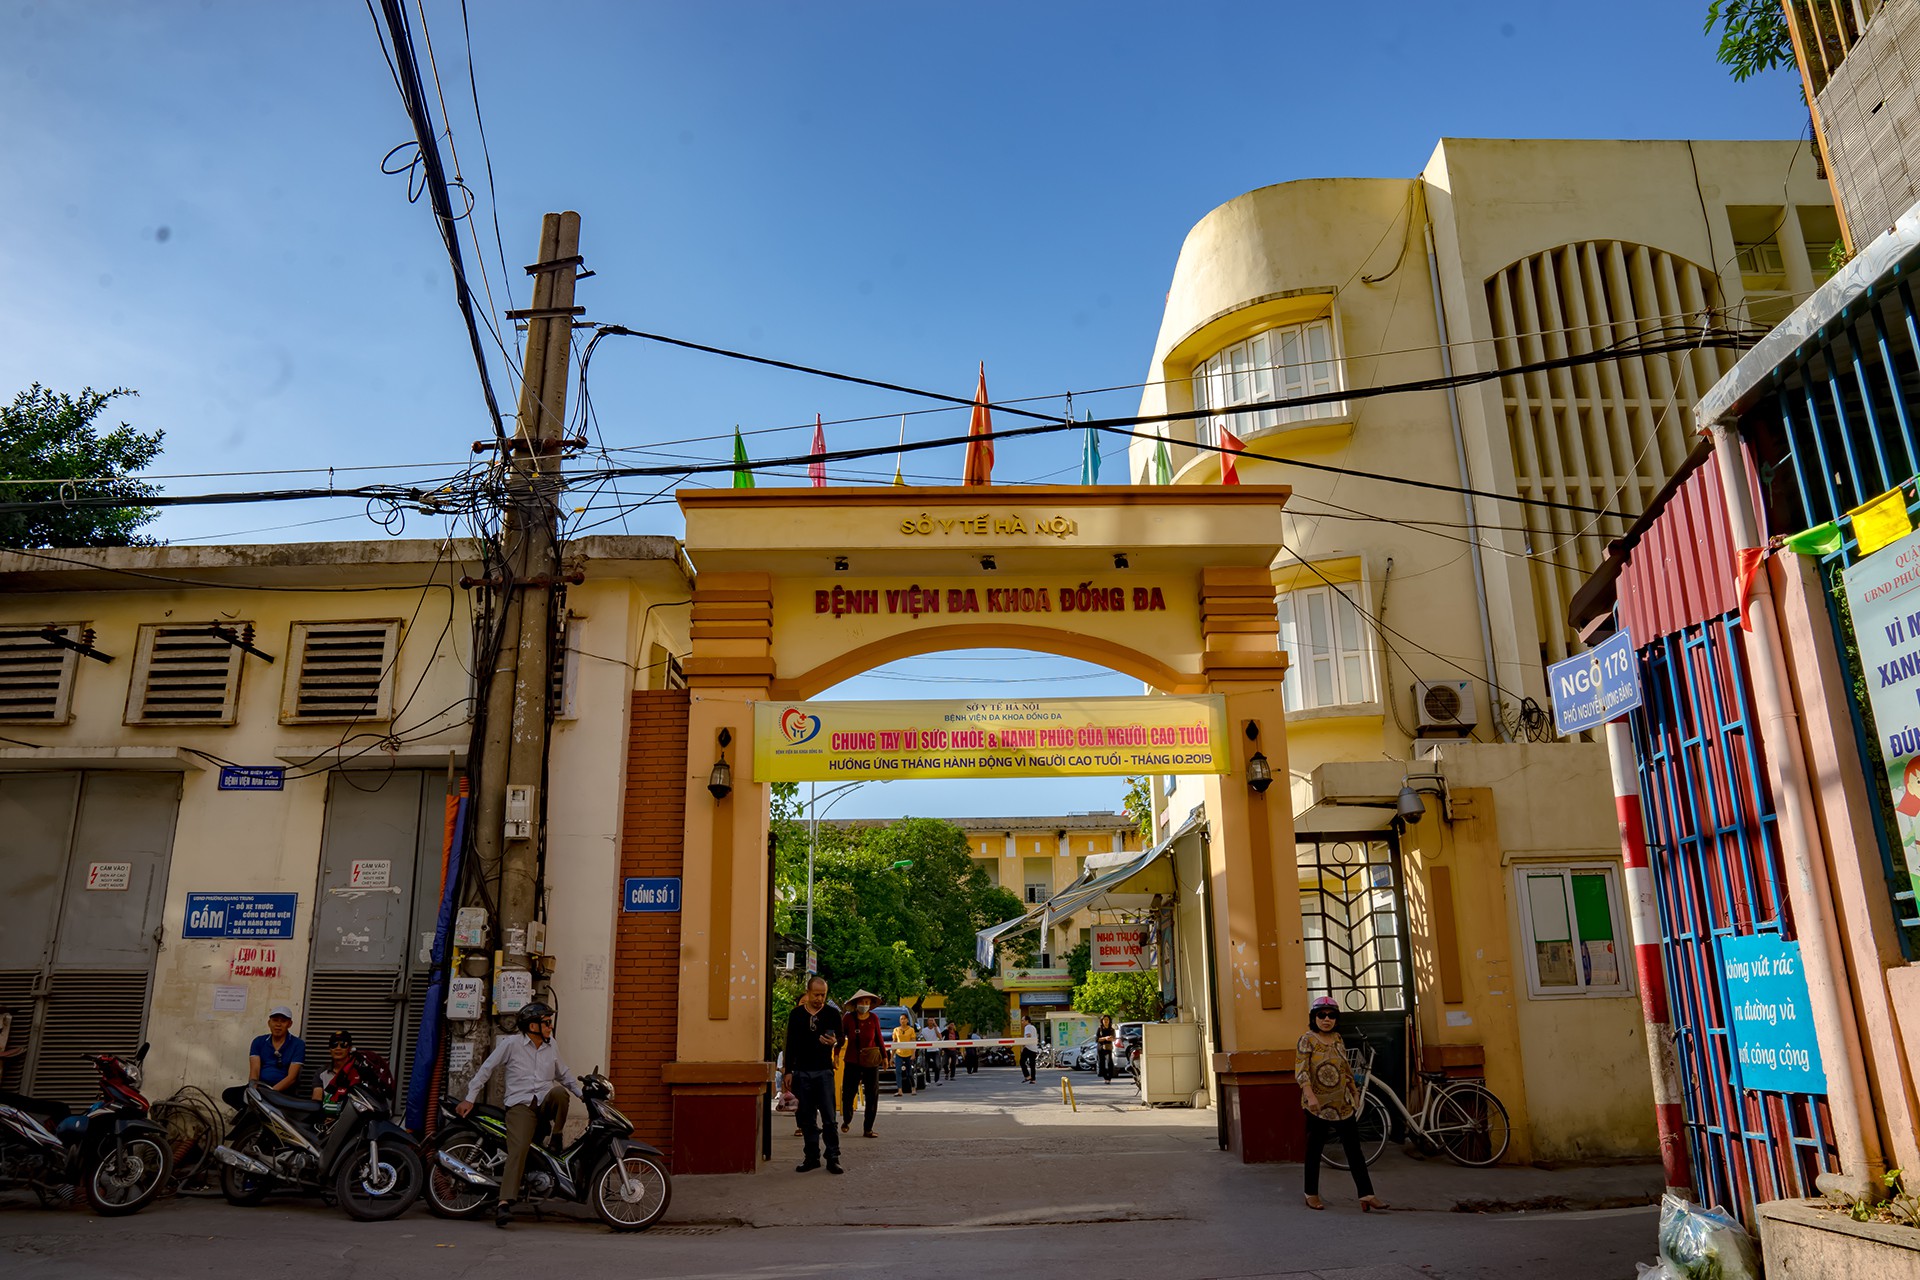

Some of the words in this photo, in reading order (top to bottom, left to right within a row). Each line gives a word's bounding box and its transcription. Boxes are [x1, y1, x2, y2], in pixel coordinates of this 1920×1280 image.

[900, 512, 934, 535] SỞ
[938, 519, 955, 535] Y
[960, 513, 989, 535] TẾ
[995, 514, 1027, 535] HÀ
[1035, 516, 1074, 538] NỘI
[815, 584, 878, 619] BỆNH
[886, 584, 940, 619] VIỆN
[947, 588, 980, 613] ĐA
[986, 588, 1051, 613] KHOA
[1059, 581, 1126, 612] ĐỐNG
[1133, 587, 1166, 611] ĐA
[1864, 581, 1892, 603] UBND
[1885, 616, 1905, 647] VÌ
[1604, 648, 1628, 679] 178
[944, 713, 966, 722] BỆNH
[969, 713, 987, 722] VIỆN
[1002, 713, 1024, 721] KHOA
[1026, 712, 1049, 720] ĐỐNG
[966, 702, 980, 711] SỞ
[990, 701, 1003, 711] TẾ
[1005, 702, 1019, 711] HÀ
[1022, 702, 1040, 712] NỘI
[1563, 703, 1577, 724] PHỐ
[831, 732, 876, 751] CHUNG
[879, 731, 900, 750] TAY
[903, 727, 917, 749] VÌ
[921, 728, 947, 749] SỨC
[951, 726, 984, 749] KHỎE
[988, 733, 998, 748] &
[1001, 730, 1036, 752] HẠNH
[1039, 724, 1074, 747] PHÚC
[1078, 723, 1104, 746] CỦA
[1107, 724, 1147, 746] NGƯỜI
[1151, 727, 1175, 745] CAO
[1178, 721, 1208, 745] TUỔI
[873, 757, 898, 769] ỨNG
[901, 756, 940, 768] THÁNG
[943, 755, 976, 768] HÀNH
[978, 755, 1012, 770] ĐỘNG
[1014, 755, 1026, 766] VÌ
[1029, 754, 1066, 767] NGƯỜI
[1068, 755, 1092, 766] CAO
[1094, 751, 1121, 765] TUỔI
[1131, 753, 1170, 765] THÁNG
[1172, 753, 1212, 765] 10.2019
[632, 884, 655, 903] CỔNG
[656, 884, 669, 903] SỐ
[670, 889, 674, 903] 1
[190, 904, 224, 929] CẤM
[1096, 931, 1114, 942] NHÀ
[1116, 929, 1141, 942] THUỐ
[1100, 944, 1121, 957] BỆNH
[1751, 954, 1770, 977] vứt
[1773, 952, 1794, 976] rác
[1744, 999, 1776, 1026] đường
[1779, 997, 1797, 1021] và
[1751, 1042, 1777, 1070] công
[1779, 1042, 1810, 1071] cộng
